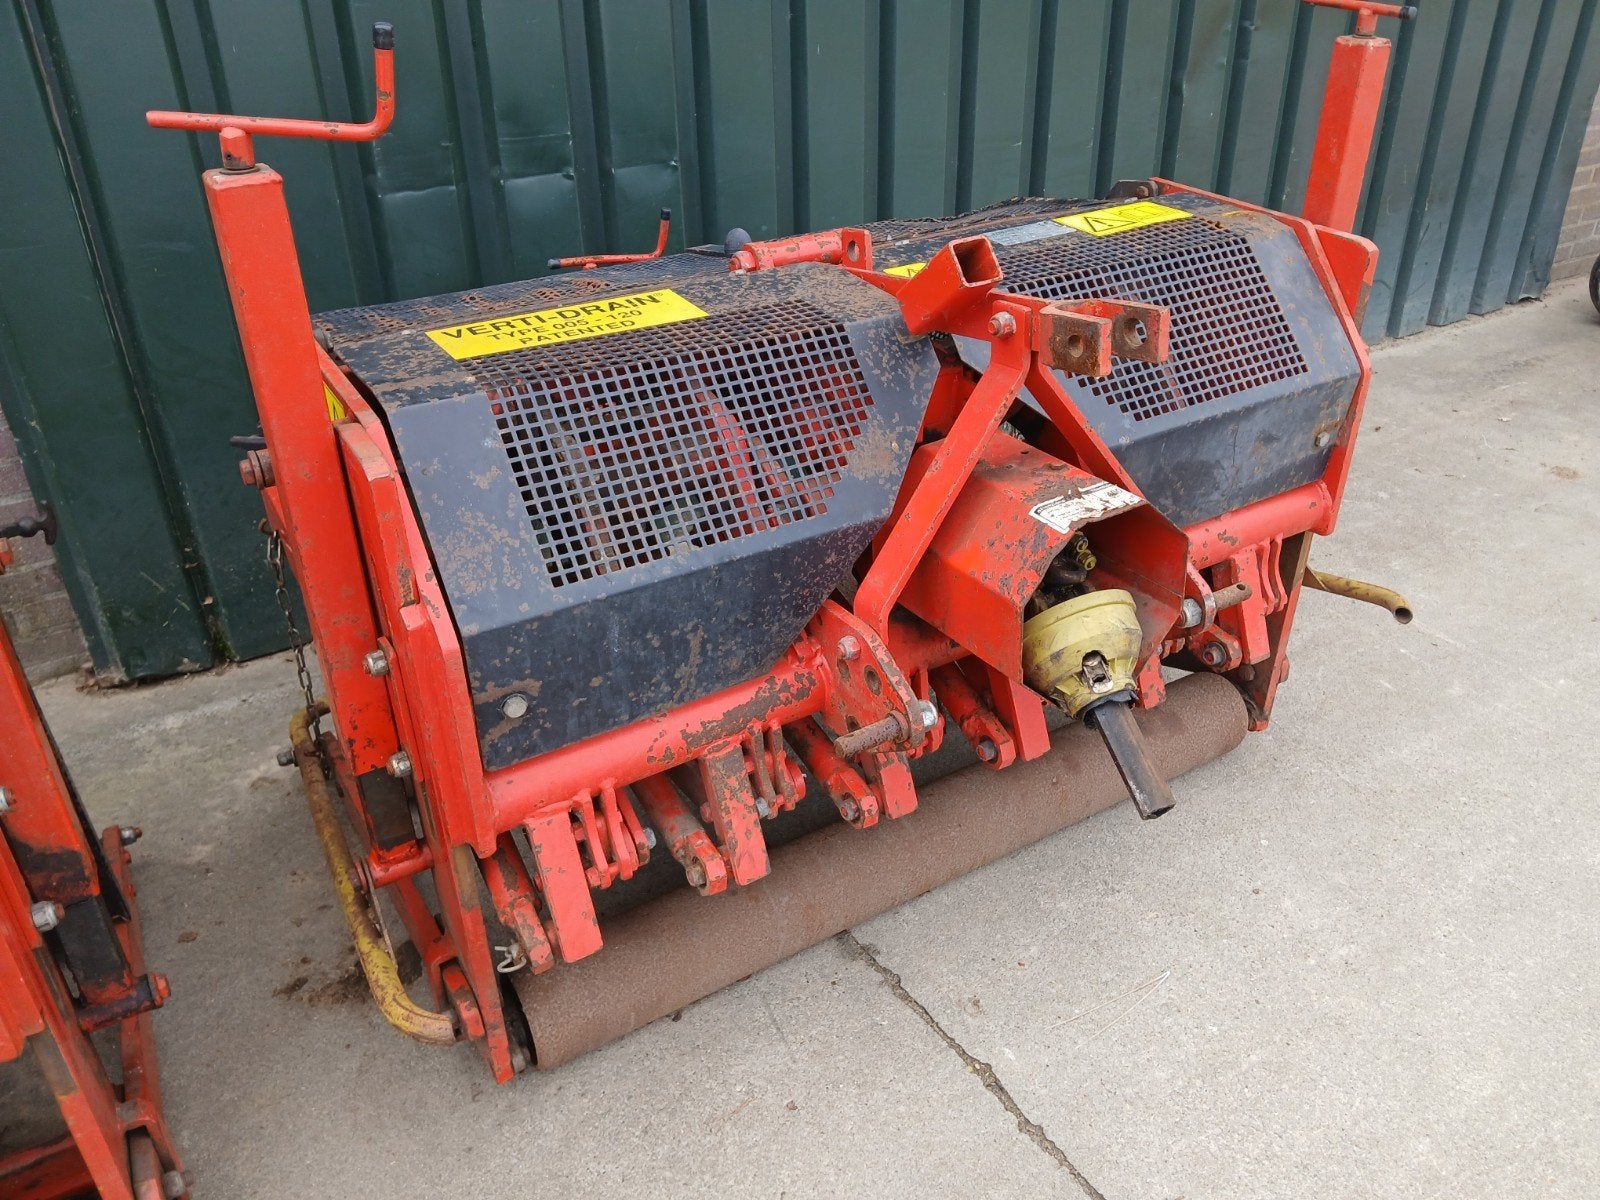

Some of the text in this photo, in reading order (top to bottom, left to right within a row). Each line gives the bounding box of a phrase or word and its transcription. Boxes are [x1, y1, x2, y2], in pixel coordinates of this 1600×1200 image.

[488, 327, 549, 340] TYPE
[553, 319, 589, 330] 005
[607, 309, 643, 320] 120
[519, 320, 636, 344] PATENTED
